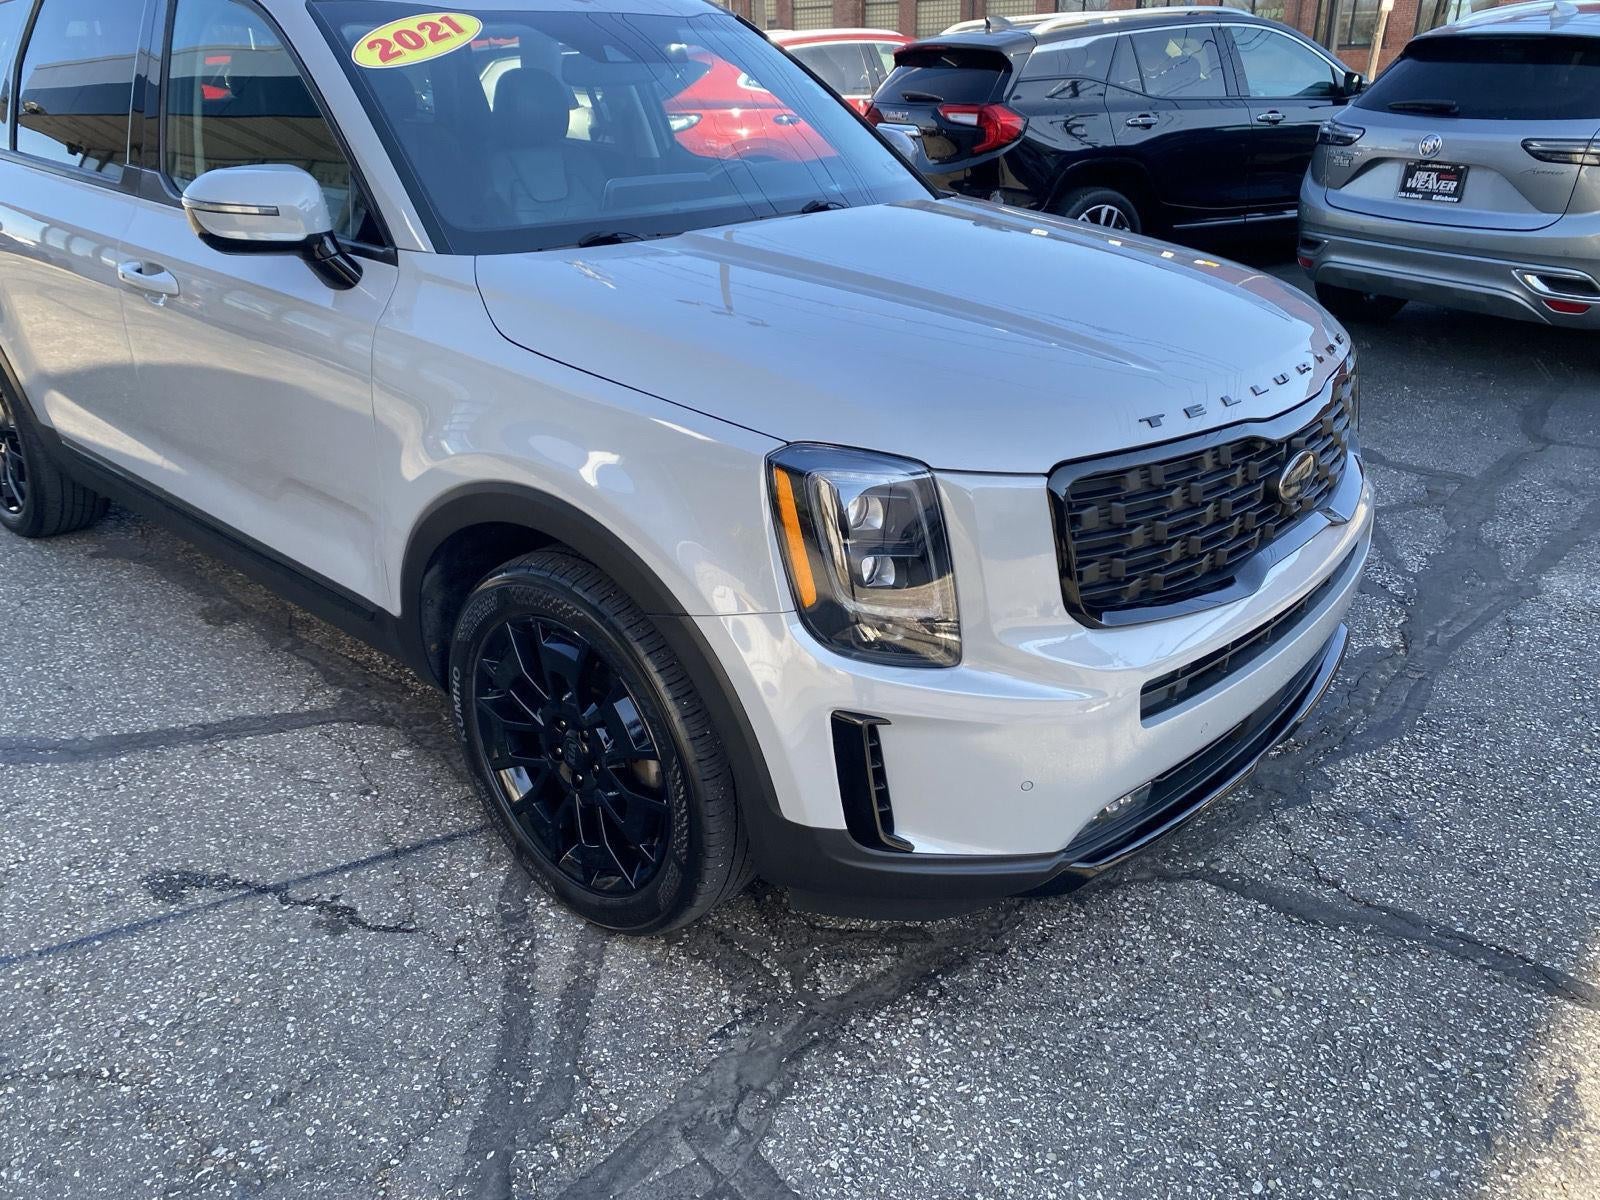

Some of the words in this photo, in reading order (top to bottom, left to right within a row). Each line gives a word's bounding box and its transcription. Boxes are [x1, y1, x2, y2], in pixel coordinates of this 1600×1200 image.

[366, 15, 465, 63] 2021
[1406, 178, 1458, 191] WEAVER
[1413, 170, 1439, 181] RICK
[1138, 332, 1345, 428] TELLURIDE
[452, 666, 468, 743] KUMHO
